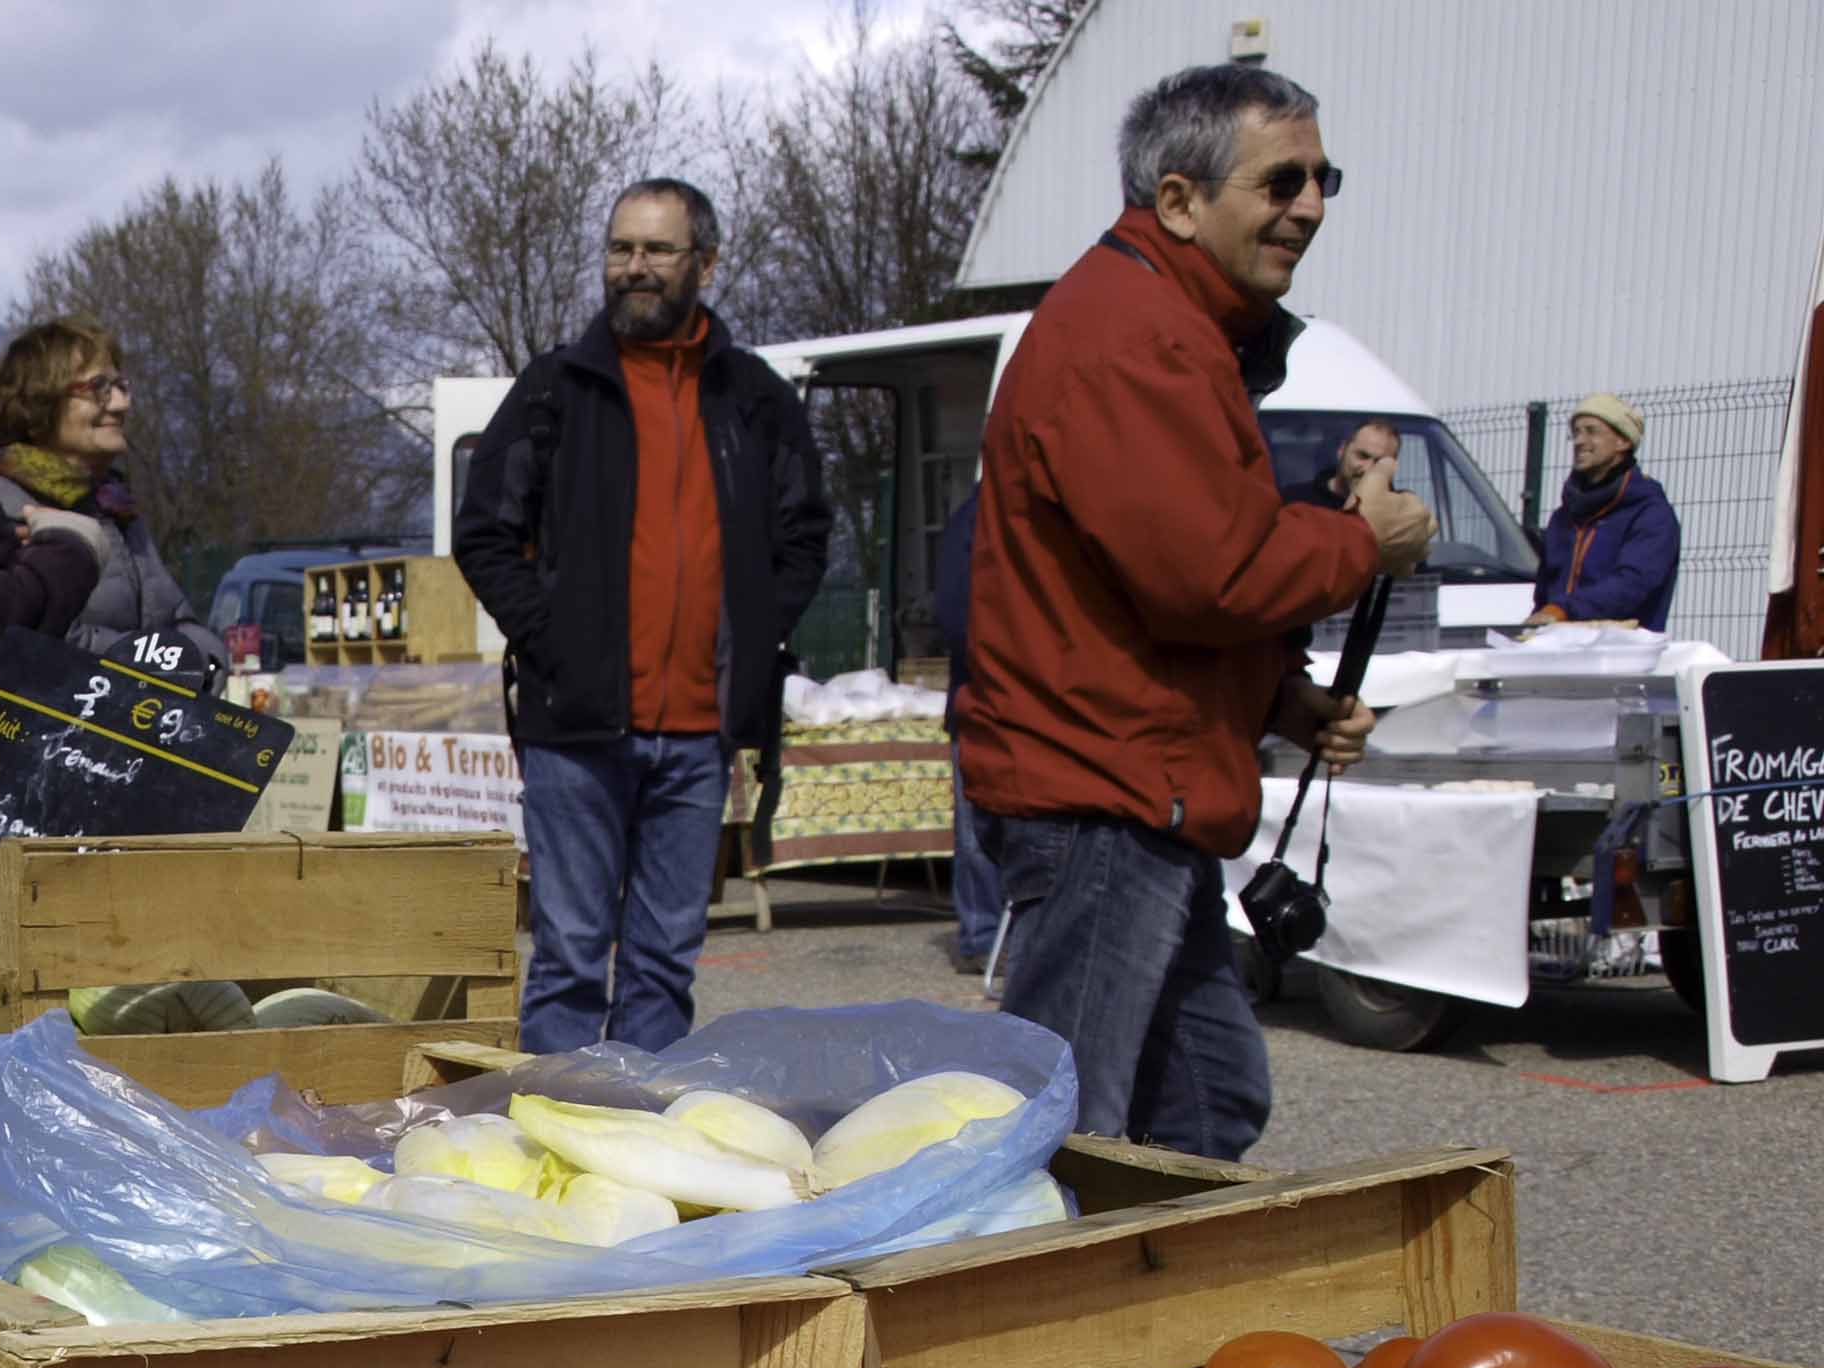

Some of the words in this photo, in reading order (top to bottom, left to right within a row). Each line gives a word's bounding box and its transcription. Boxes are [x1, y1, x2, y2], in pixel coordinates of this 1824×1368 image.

[133, 632, 182, 671] 1kg
[371, 735, 407, 770] Bio
[416, 738, 432, 774] &
[1717, 794, 1750, 825] DE
